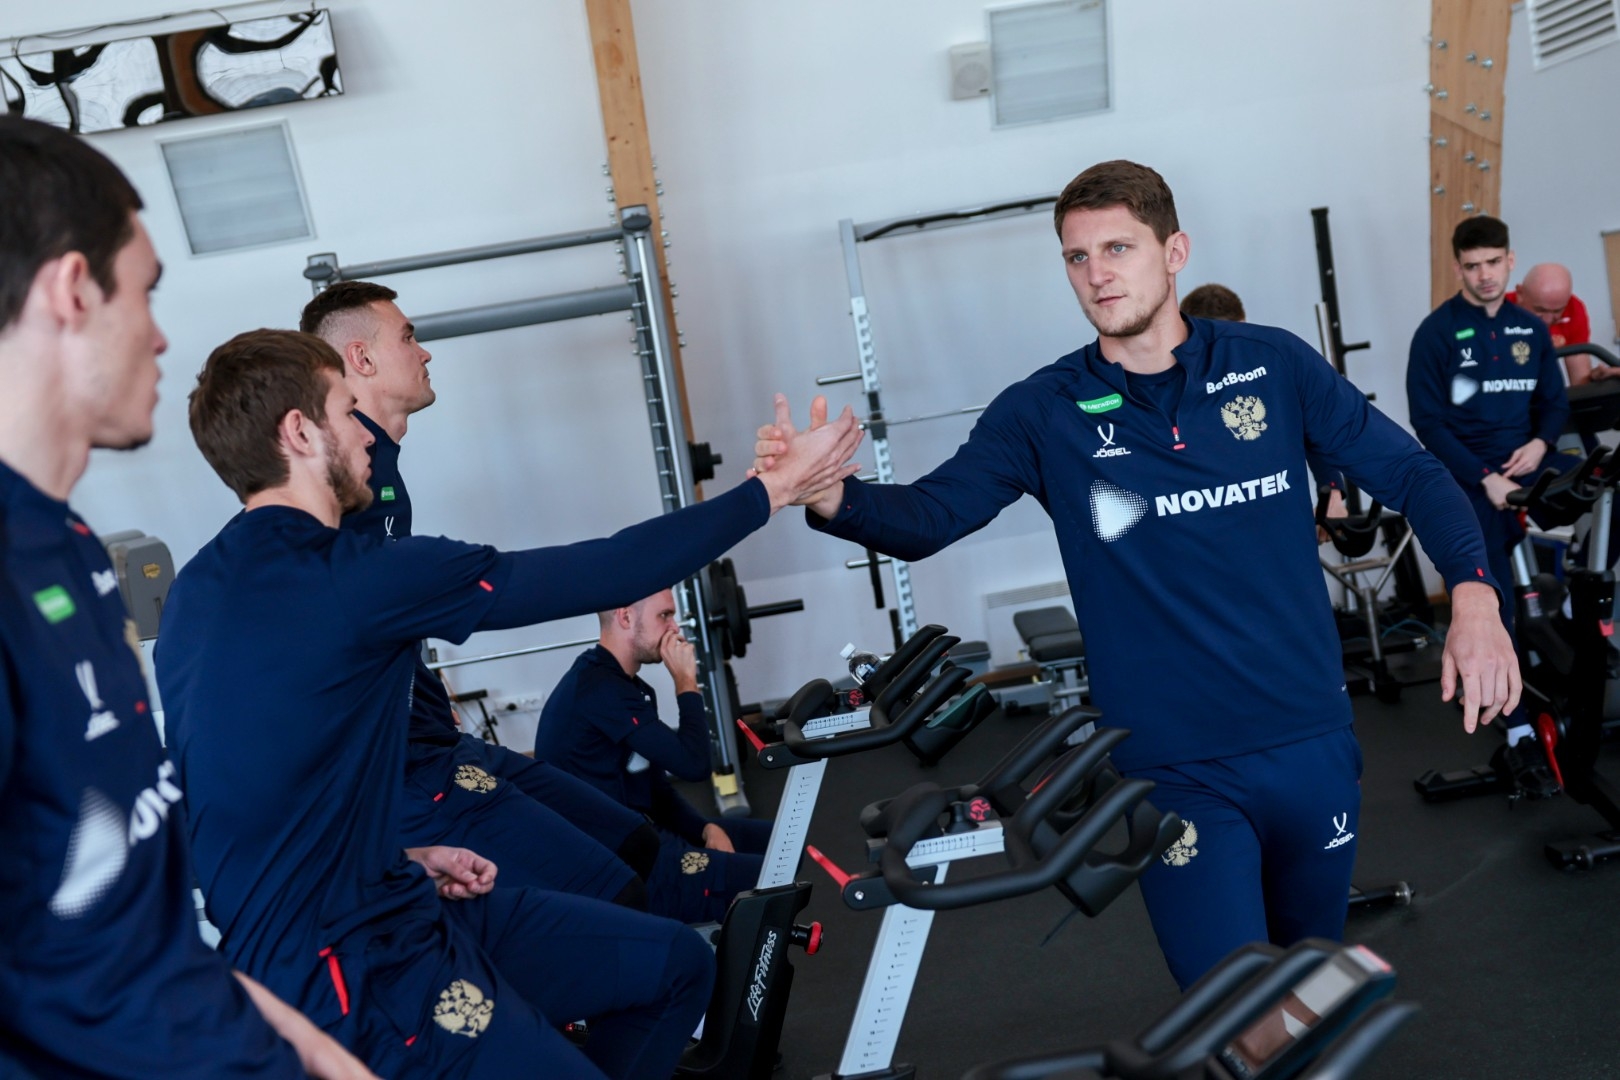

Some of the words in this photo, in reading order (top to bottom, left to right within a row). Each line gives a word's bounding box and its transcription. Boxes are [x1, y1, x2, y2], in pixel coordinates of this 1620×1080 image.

[1206, 366, 1267, 394] BetBoom
[1092, 447, 1131, 458] JÖGEL
[1155, 469, 1291, 517] NOVATEK
[1324, 832, 1355, 850] JÖGEL
